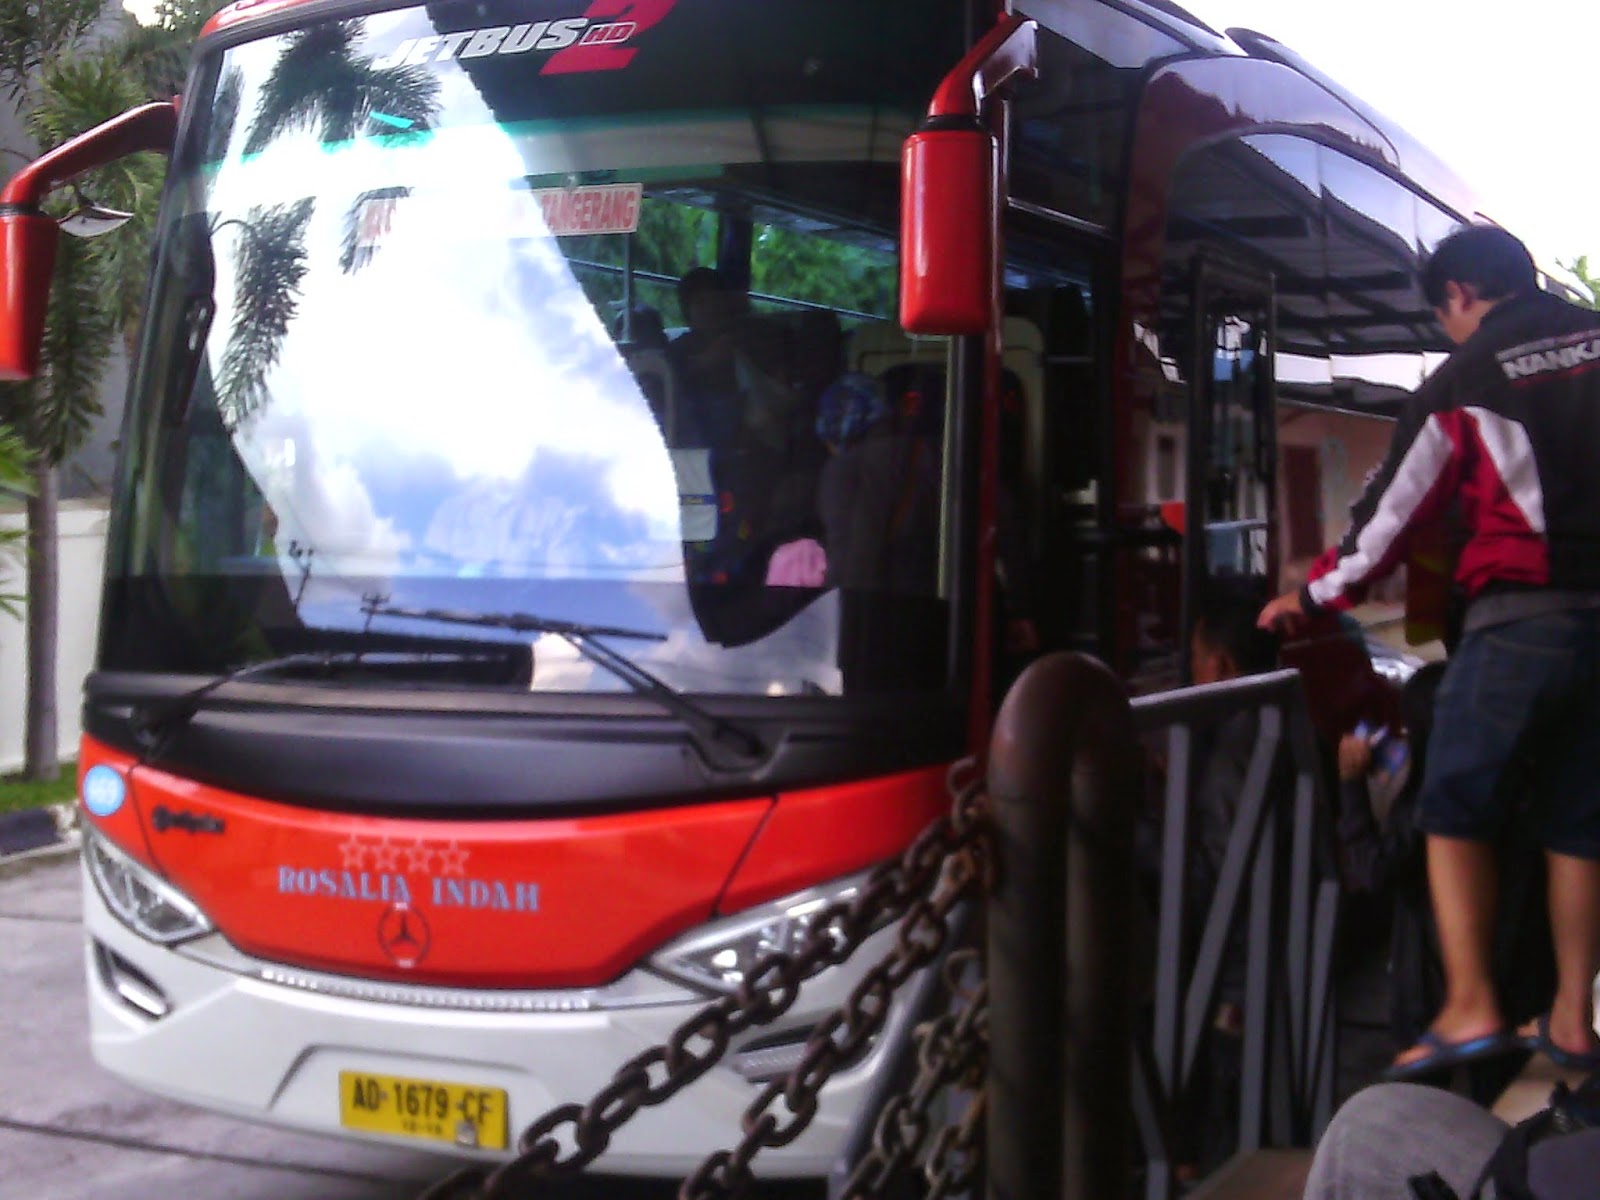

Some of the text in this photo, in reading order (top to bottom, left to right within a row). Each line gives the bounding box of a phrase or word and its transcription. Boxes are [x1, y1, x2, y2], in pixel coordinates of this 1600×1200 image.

[369, 17, 590, 71] JETBUS
[277, 865, 542, 912] ROSALIA INDAH
